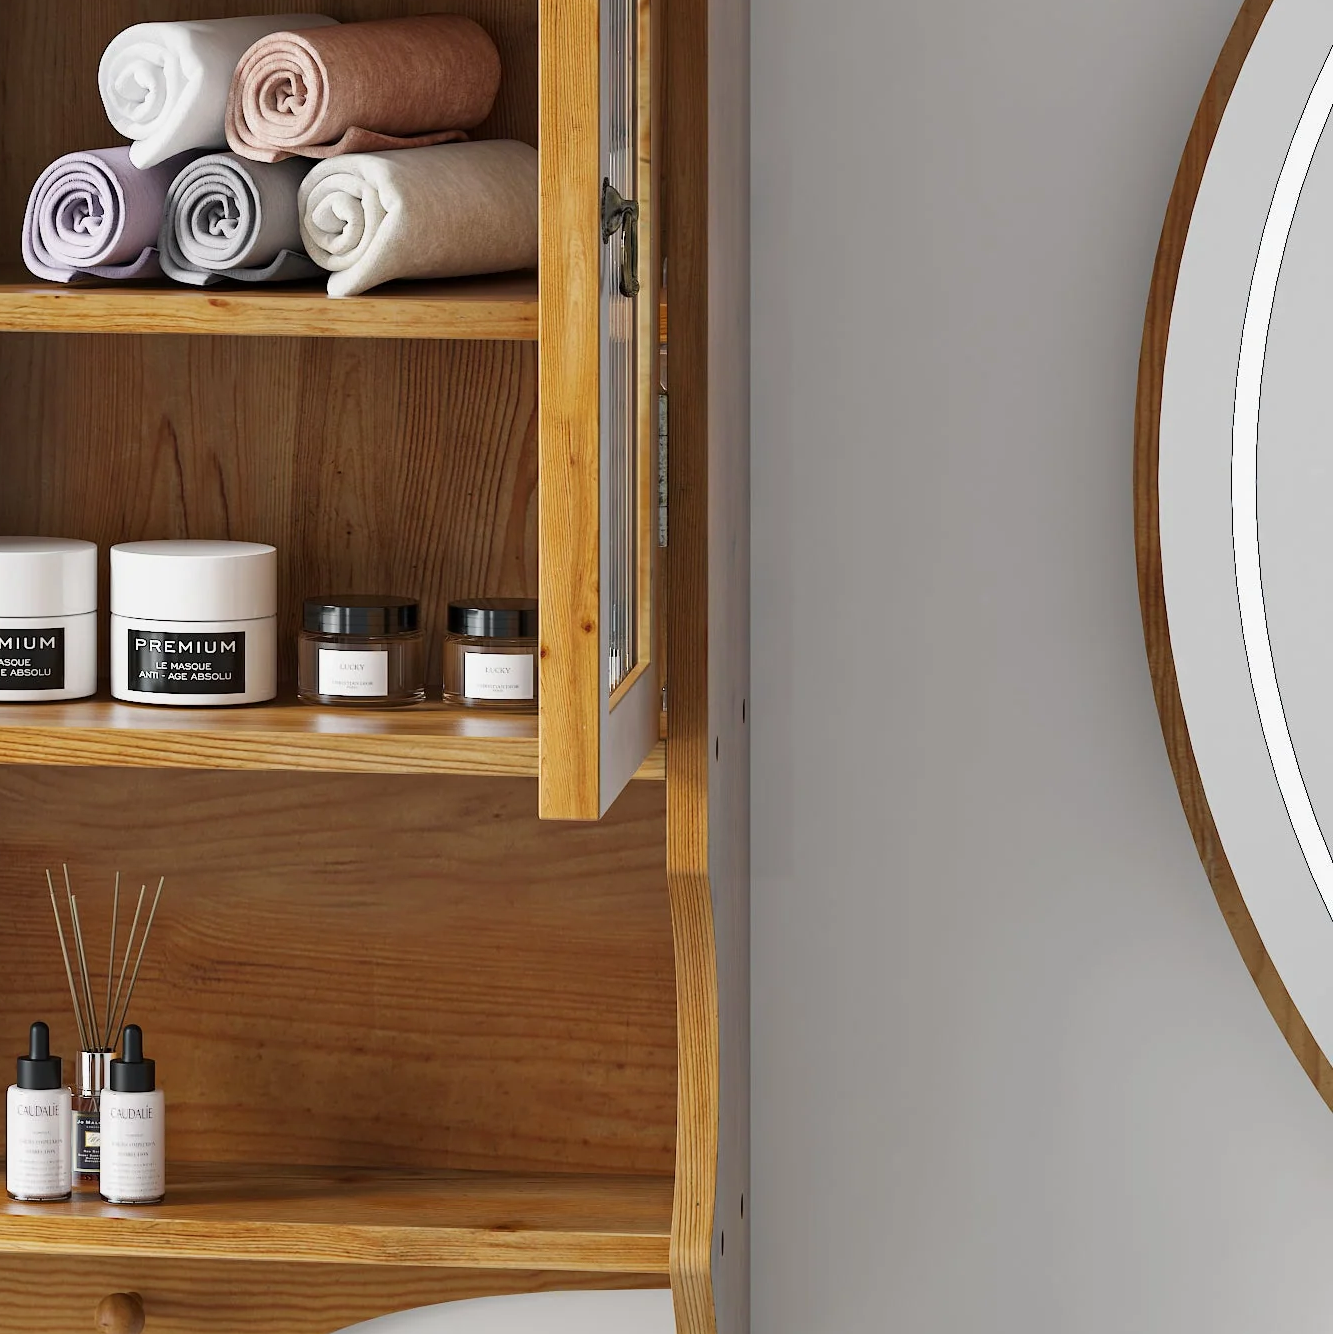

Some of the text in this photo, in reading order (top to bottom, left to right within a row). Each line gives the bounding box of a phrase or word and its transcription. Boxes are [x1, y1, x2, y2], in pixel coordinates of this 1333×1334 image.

[135, 638, 236, 654] PREMIUM
[155, 661, 212, 671] LE MASQUE
[9, 668, 51, 677] ABSOLU
[138, 670, 159, 680] ANTI
[167, 672, 188, 681] AGE
[190, 672, 232, 681] ABSOLU
